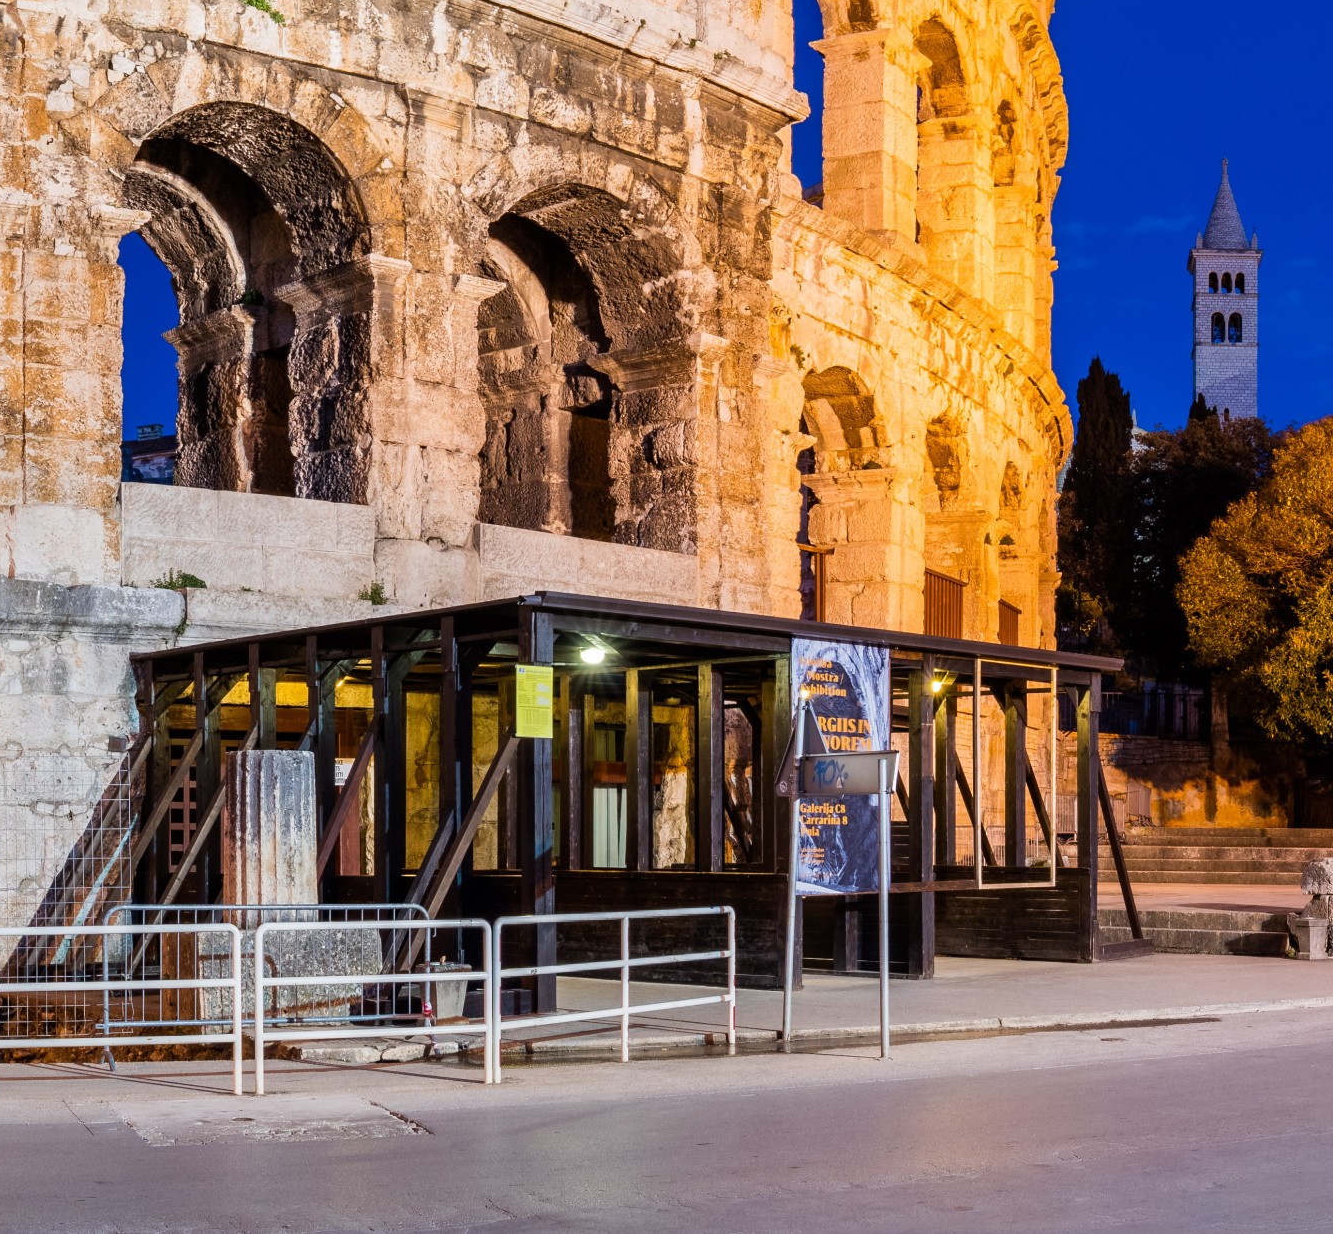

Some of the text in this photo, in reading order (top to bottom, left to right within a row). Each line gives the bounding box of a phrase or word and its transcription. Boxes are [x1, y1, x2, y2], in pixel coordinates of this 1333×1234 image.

[817, 716, 856, 733] RGIIS
[800, 802, 846, 815] Galerija C8
[800, 814, 848, 825] Carrarina 8
[800, 826, 820, 837] Pula
